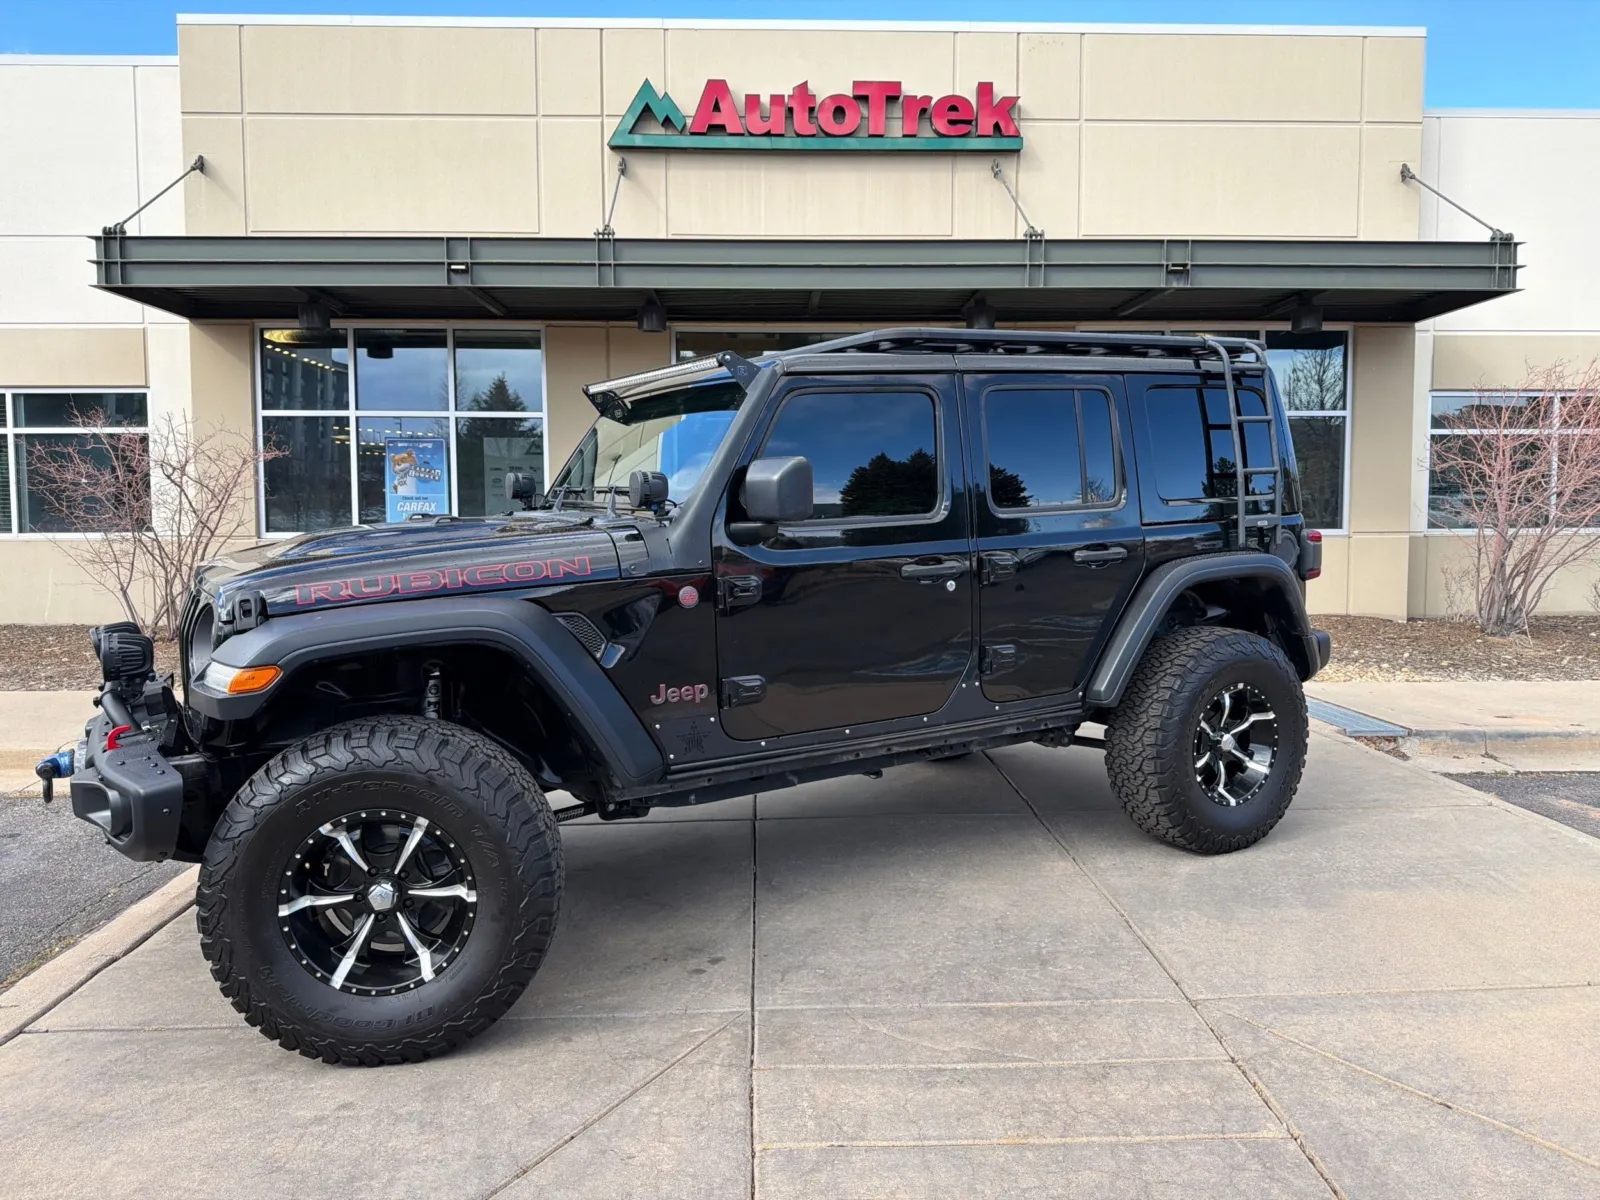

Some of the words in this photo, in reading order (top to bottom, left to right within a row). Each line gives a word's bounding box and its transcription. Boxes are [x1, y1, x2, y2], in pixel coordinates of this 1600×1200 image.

[689, 79, 1022, 137] AutoTrek
[397, 502, 437, 512] CARFAX
[294, 556, 591, 605] RUBICON
[650, 683, 709, 705] Jeep
